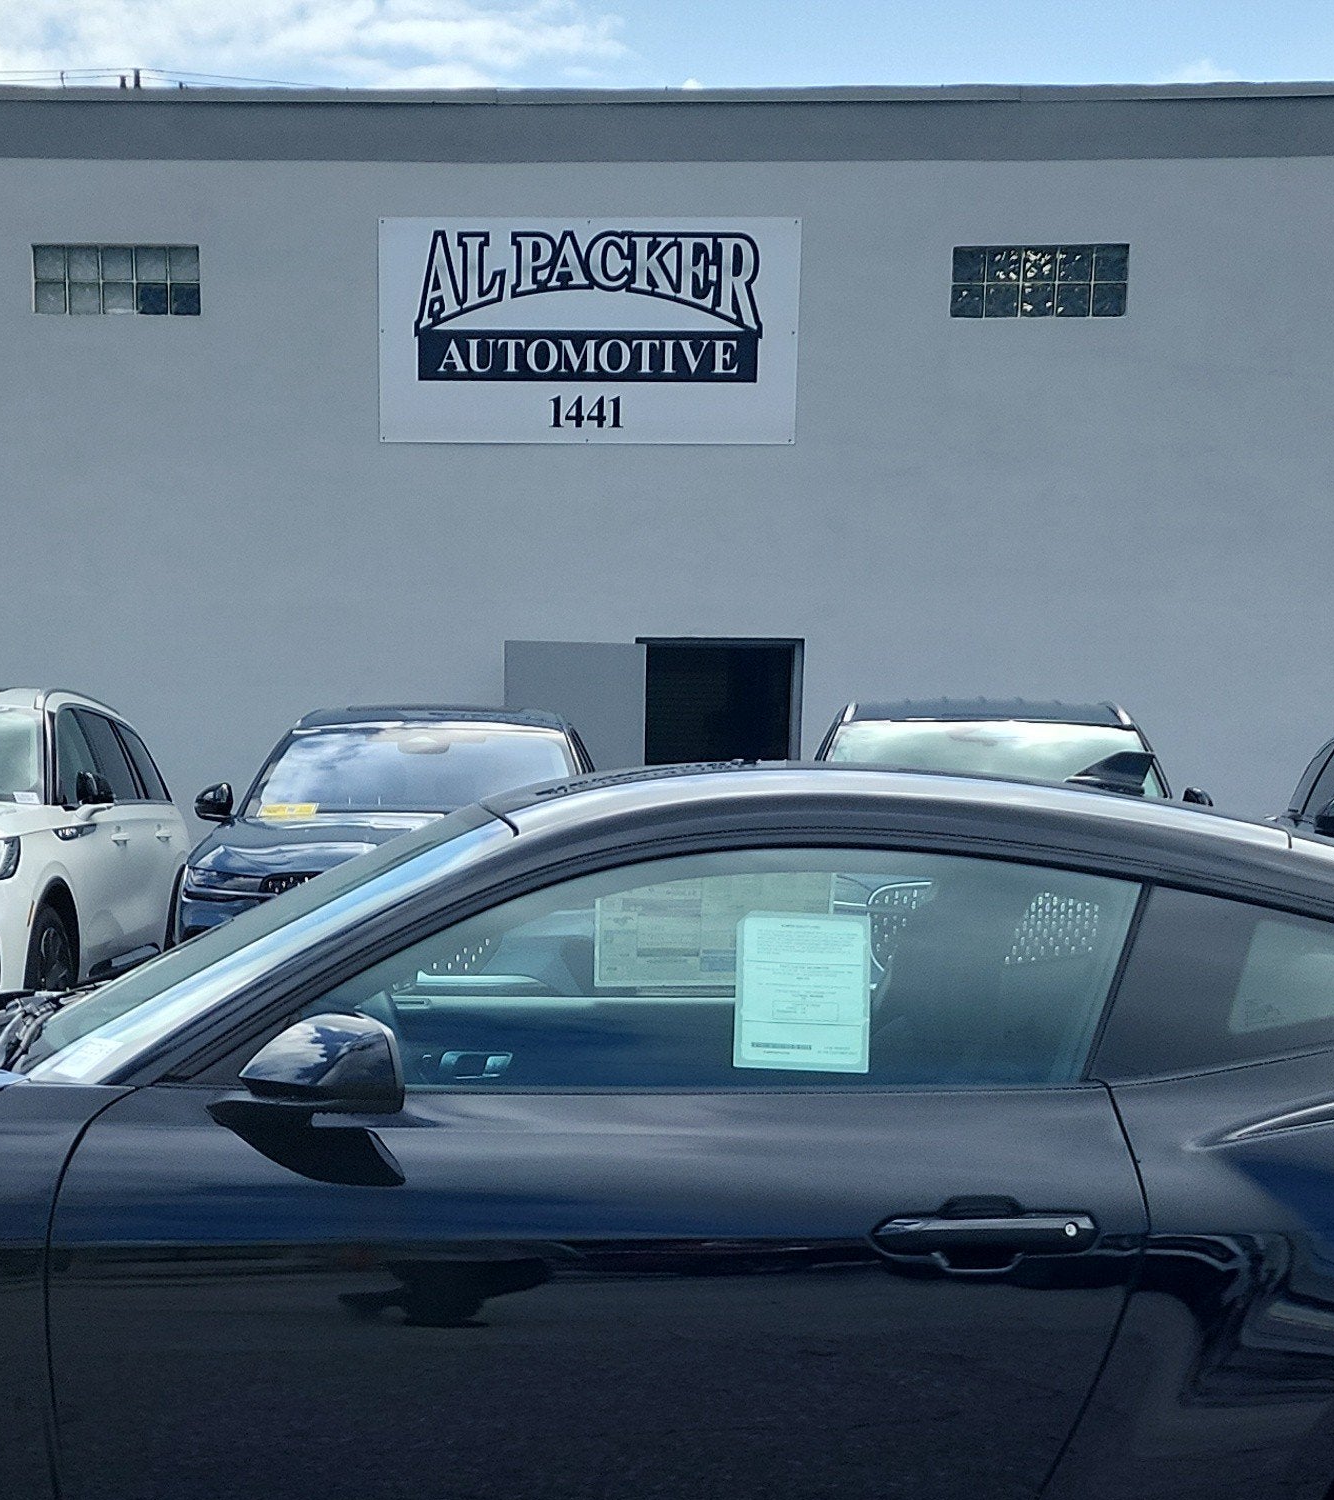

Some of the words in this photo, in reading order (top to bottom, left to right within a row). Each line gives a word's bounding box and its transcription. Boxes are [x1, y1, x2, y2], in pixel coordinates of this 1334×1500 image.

[415, 229, 506, 336] AL
[510, 229, 762, 337] PACKER
[437, 338, 740, 375] AUTOMOTIVE
[548, 395, 624, 429] 1441
